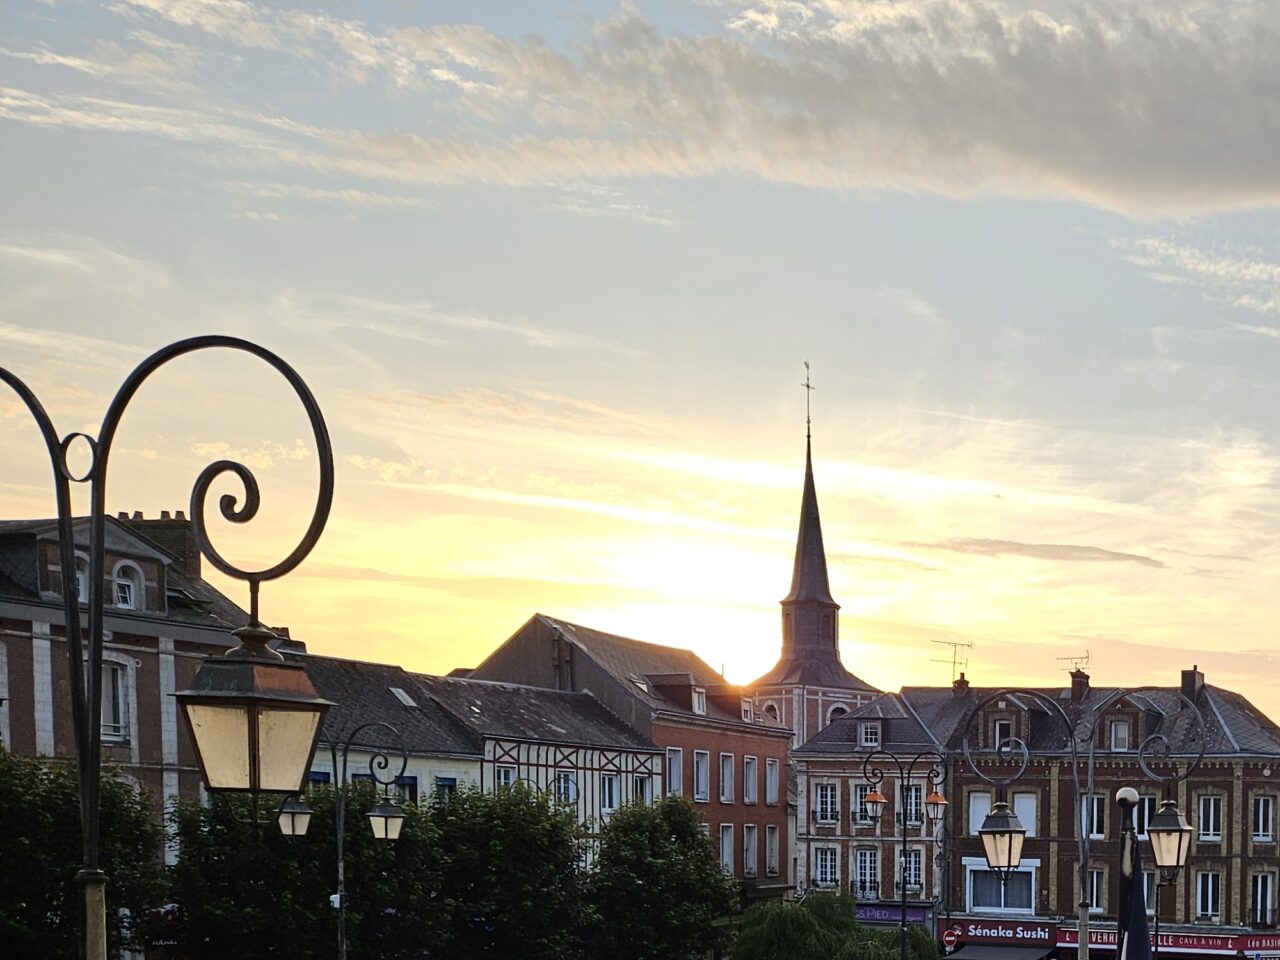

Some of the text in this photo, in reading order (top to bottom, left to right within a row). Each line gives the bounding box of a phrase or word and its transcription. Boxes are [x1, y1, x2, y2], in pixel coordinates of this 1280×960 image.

[968, 924, 1049, 940] Sénaka Sushi
[1179, 937, 1197, 945] CAVE
[1208, 938, 1222, 946] VIN
